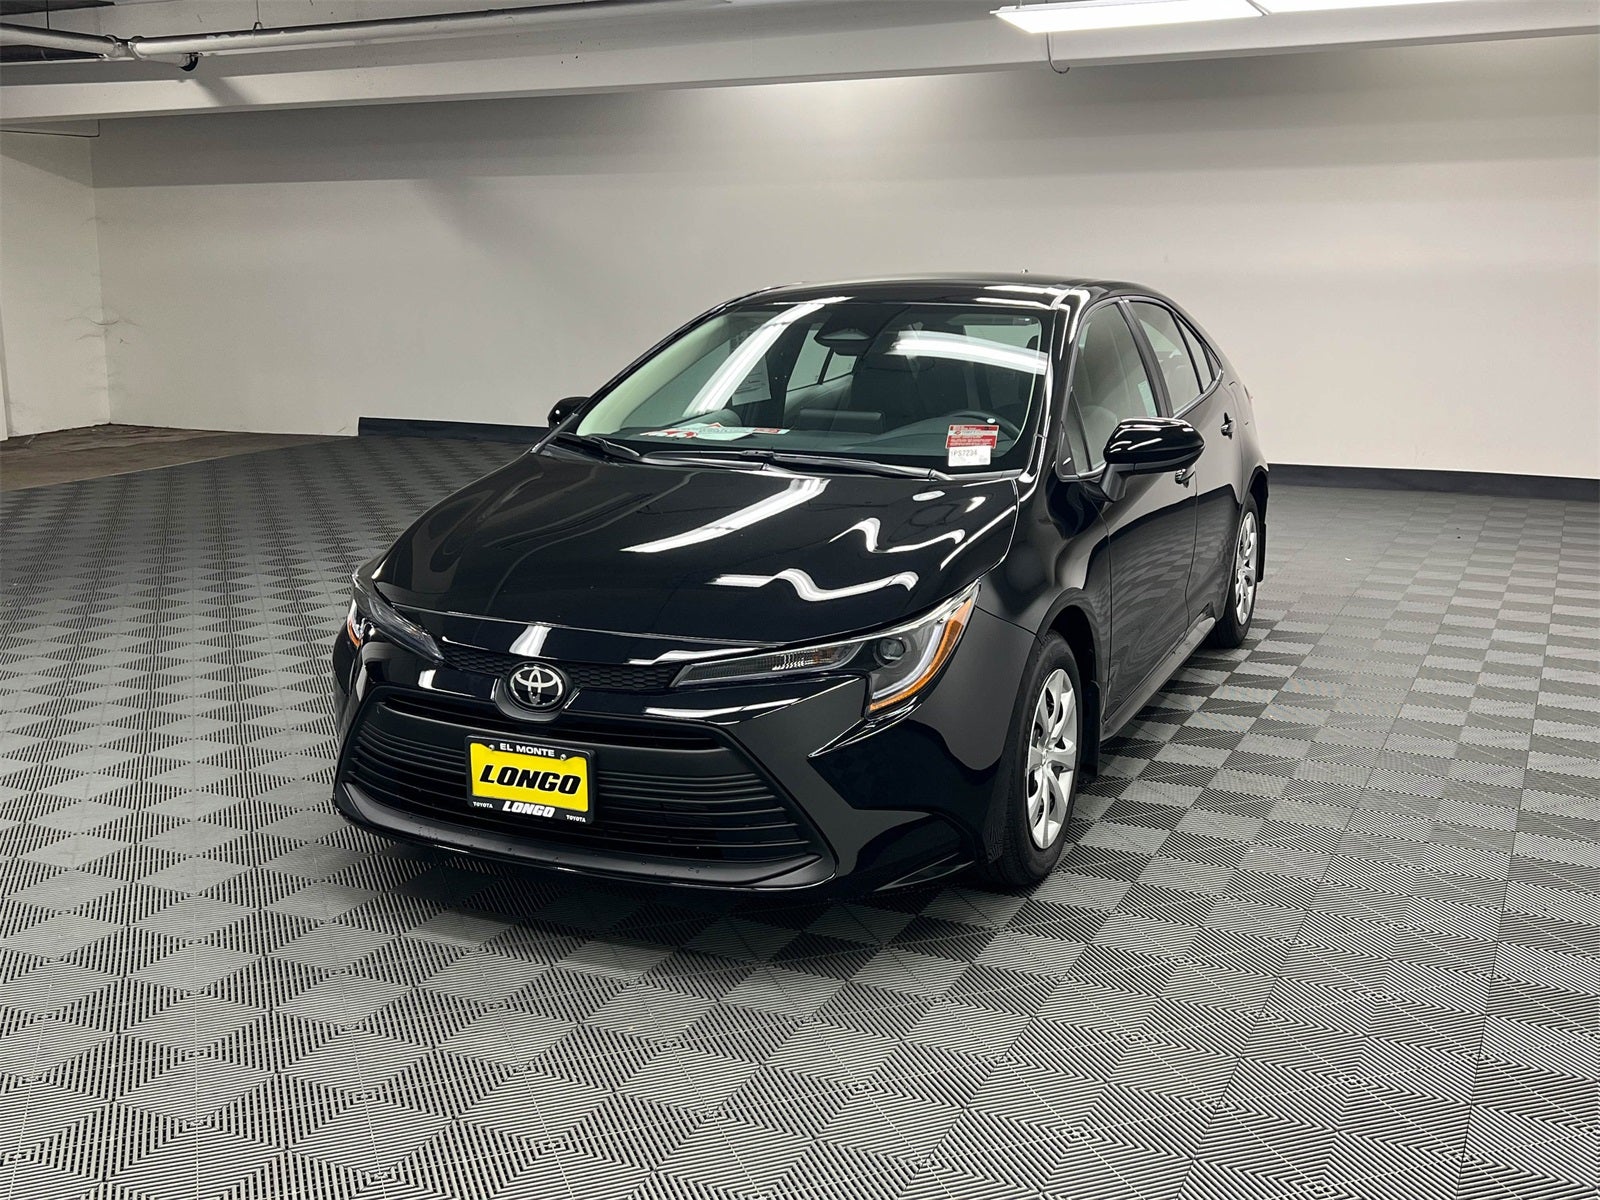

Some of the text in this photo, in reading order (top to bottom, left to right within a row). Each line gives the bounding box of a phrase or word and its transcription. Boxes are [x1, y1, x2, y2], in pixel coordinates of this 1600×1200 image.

[500, 743, 555, 757] EL MONTE
[480, 764, 581, 795] LONGO
[473, 801, 493, 809] TOYOTA
[502, 801, 555, 818] LONGO
[566, 814, 586, 823] TOYOTA
